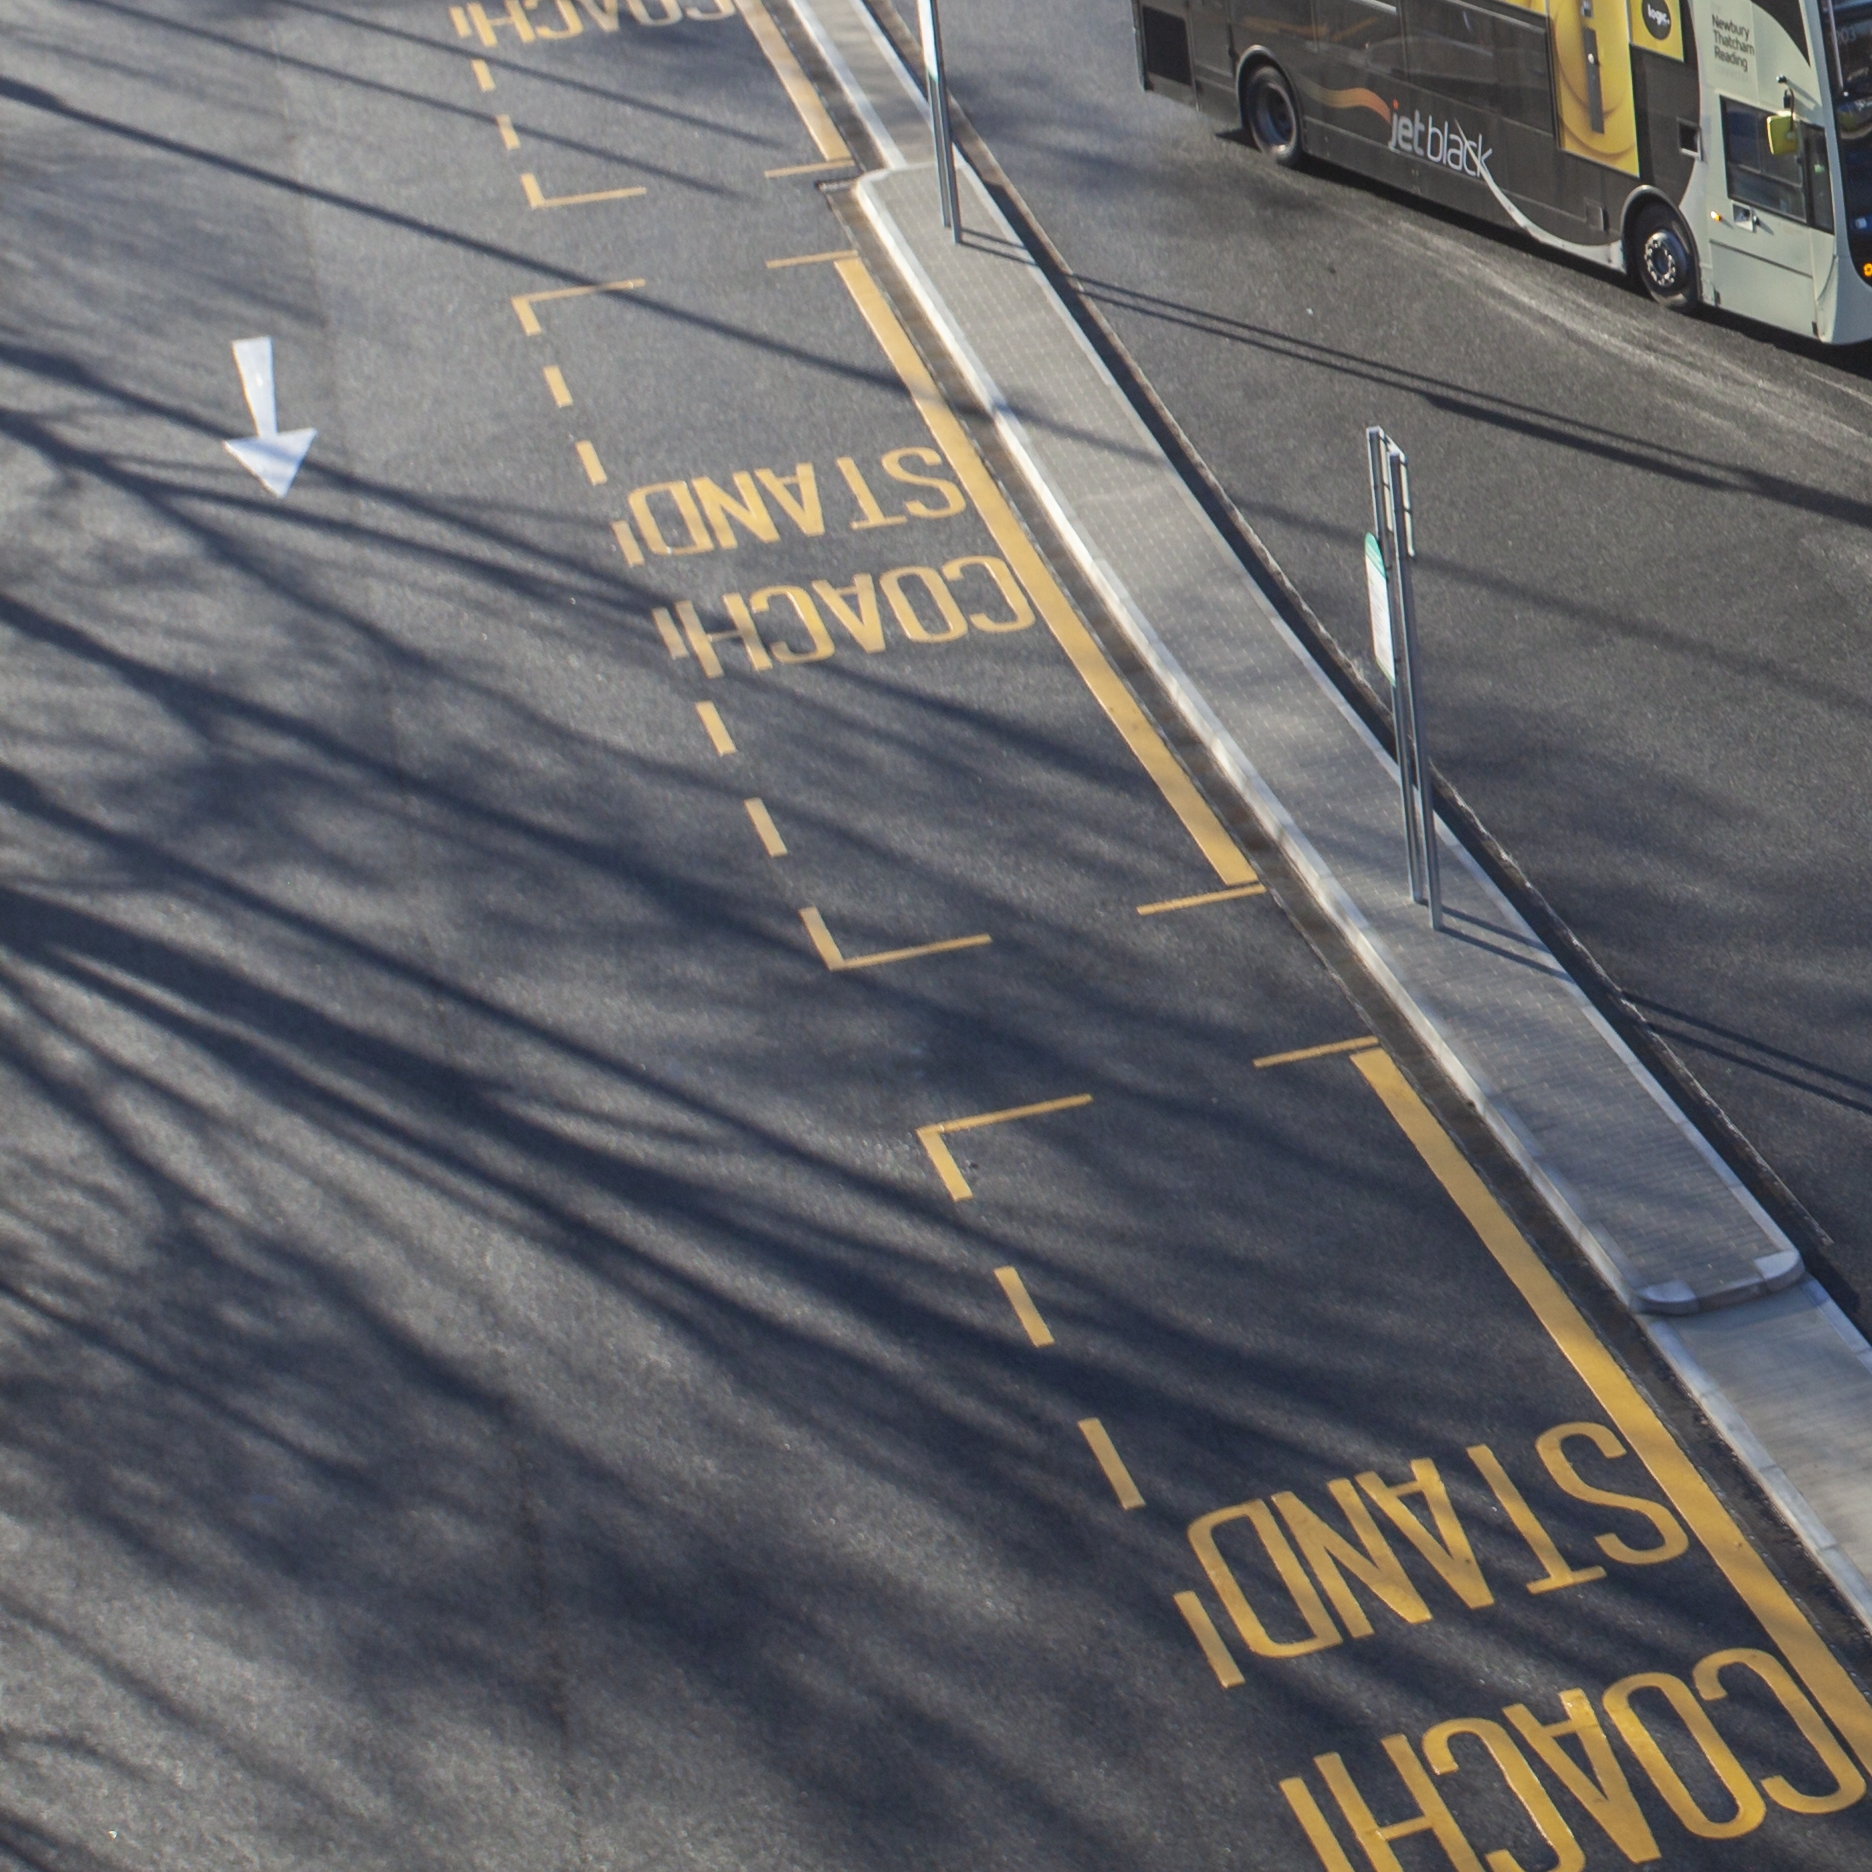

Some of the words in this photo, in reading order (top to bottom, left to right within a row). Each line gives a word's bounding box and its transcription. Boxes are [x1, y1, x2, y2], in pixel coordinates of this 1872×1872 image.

[1711, 14, 1751, 42] Newbury
[1713, 28, 1756, 56] Thatcham
[1713, 44, 1749, 73] Reading
[628, 444, 969, 558] STAND
[677, 553, 1037, 678] COACH
[1186, 1421, 1690, 1660] STAND
[1314, 1645, 1870, 1872] COACH
